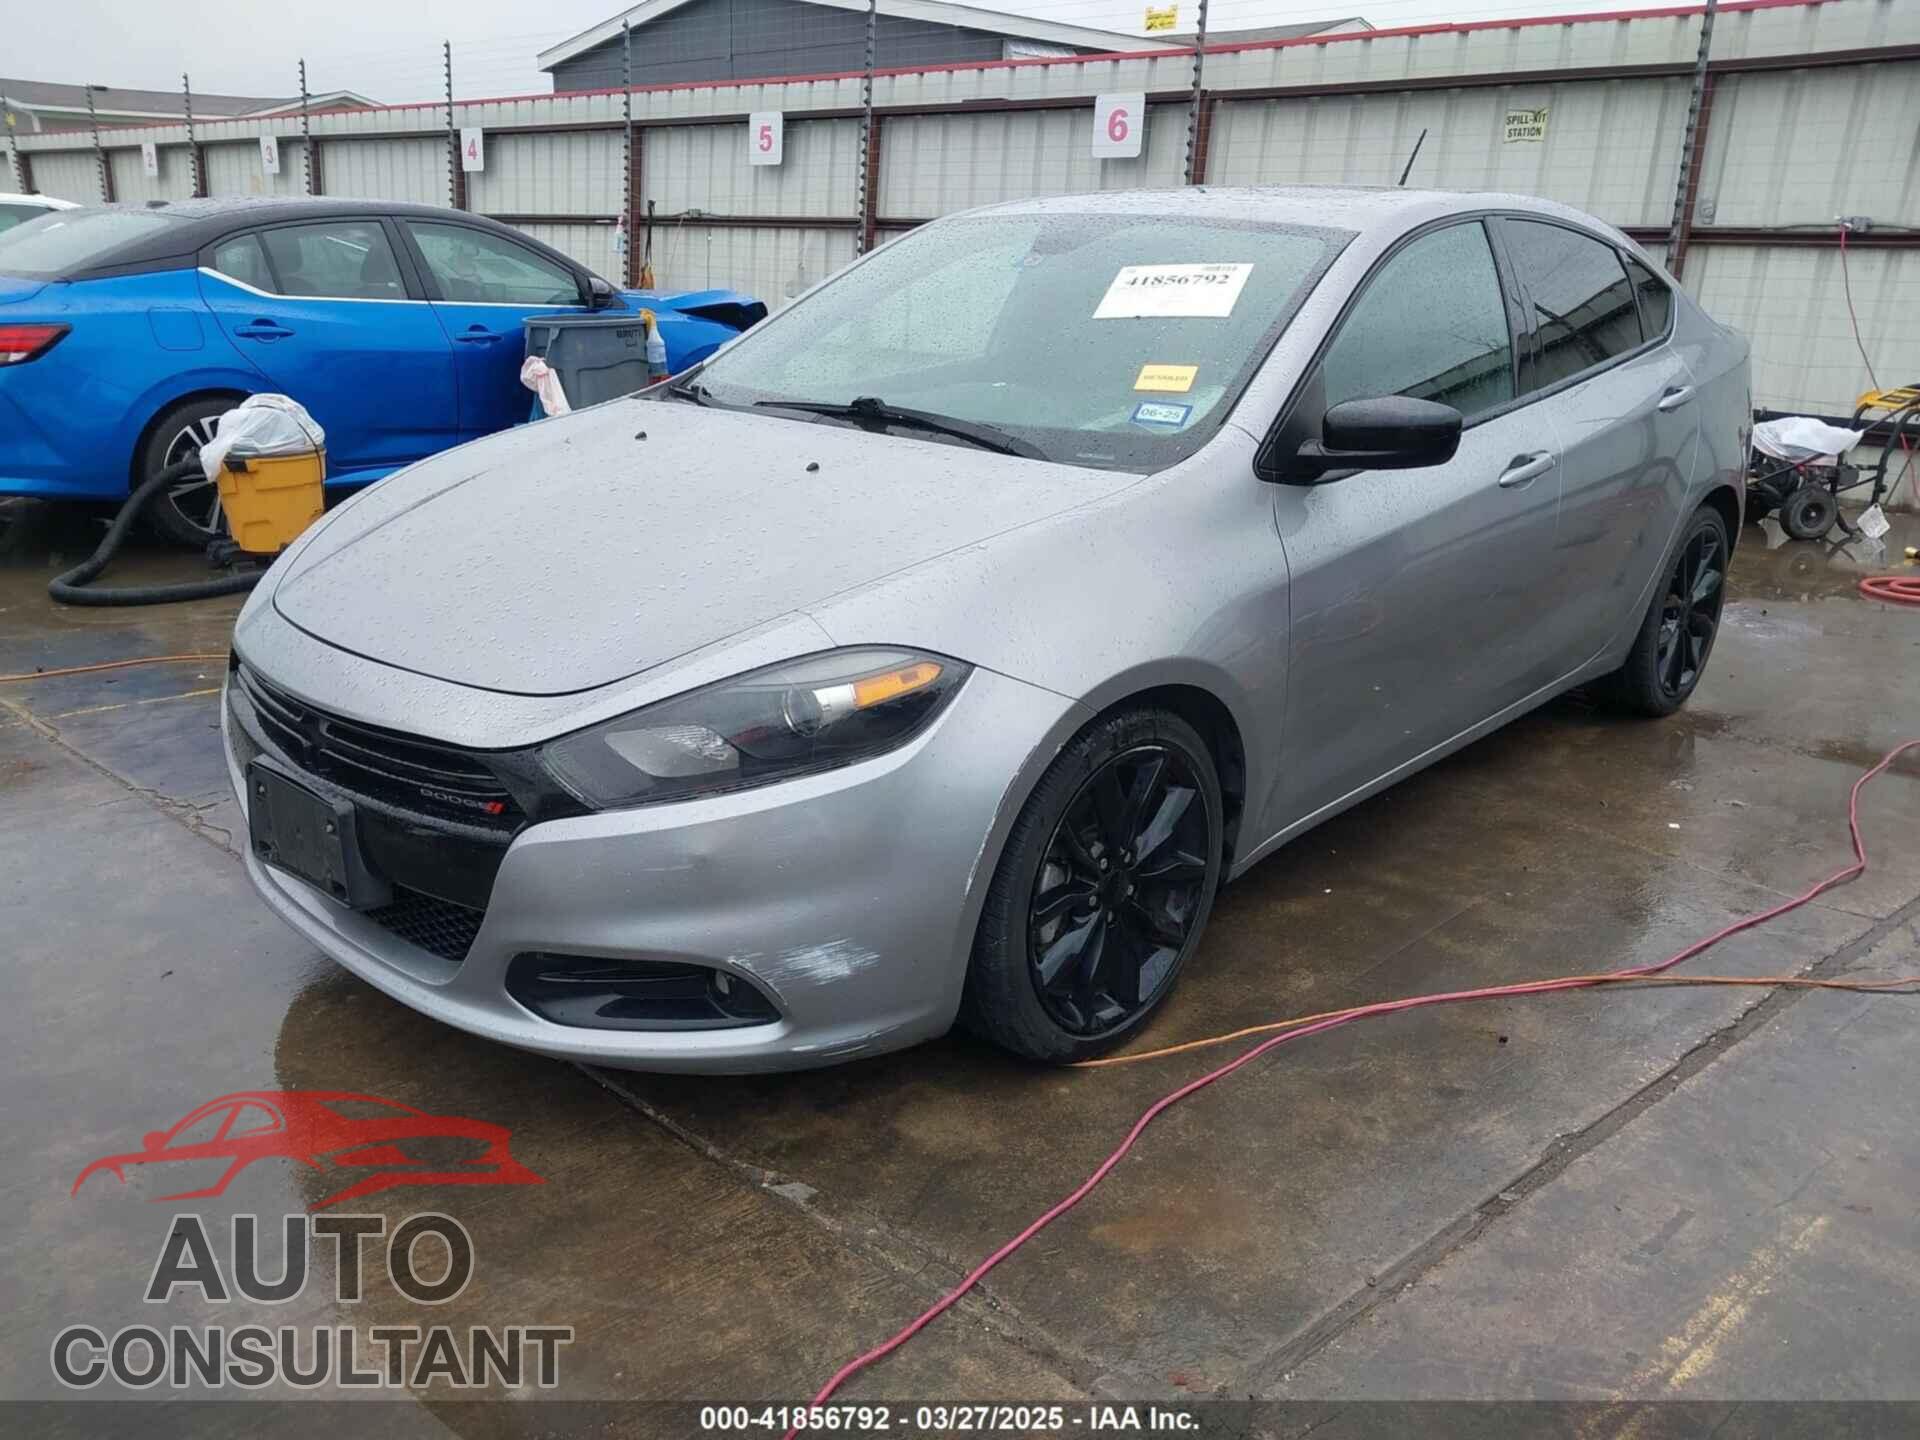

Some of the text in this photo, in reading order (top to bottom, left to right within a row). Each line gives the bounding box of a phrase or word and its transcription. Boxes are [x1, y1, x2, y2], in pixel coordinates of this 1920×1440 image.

[1108, 109, 1128, 142] 6
[1508, 127, 1542, 138] STATION
[760, 125, 772, 152] 5
[467, 138, 477, 160] 4
[1126, 274, 1230, 286] 41856792
[1141, 407, 1180, 419] 06-25
